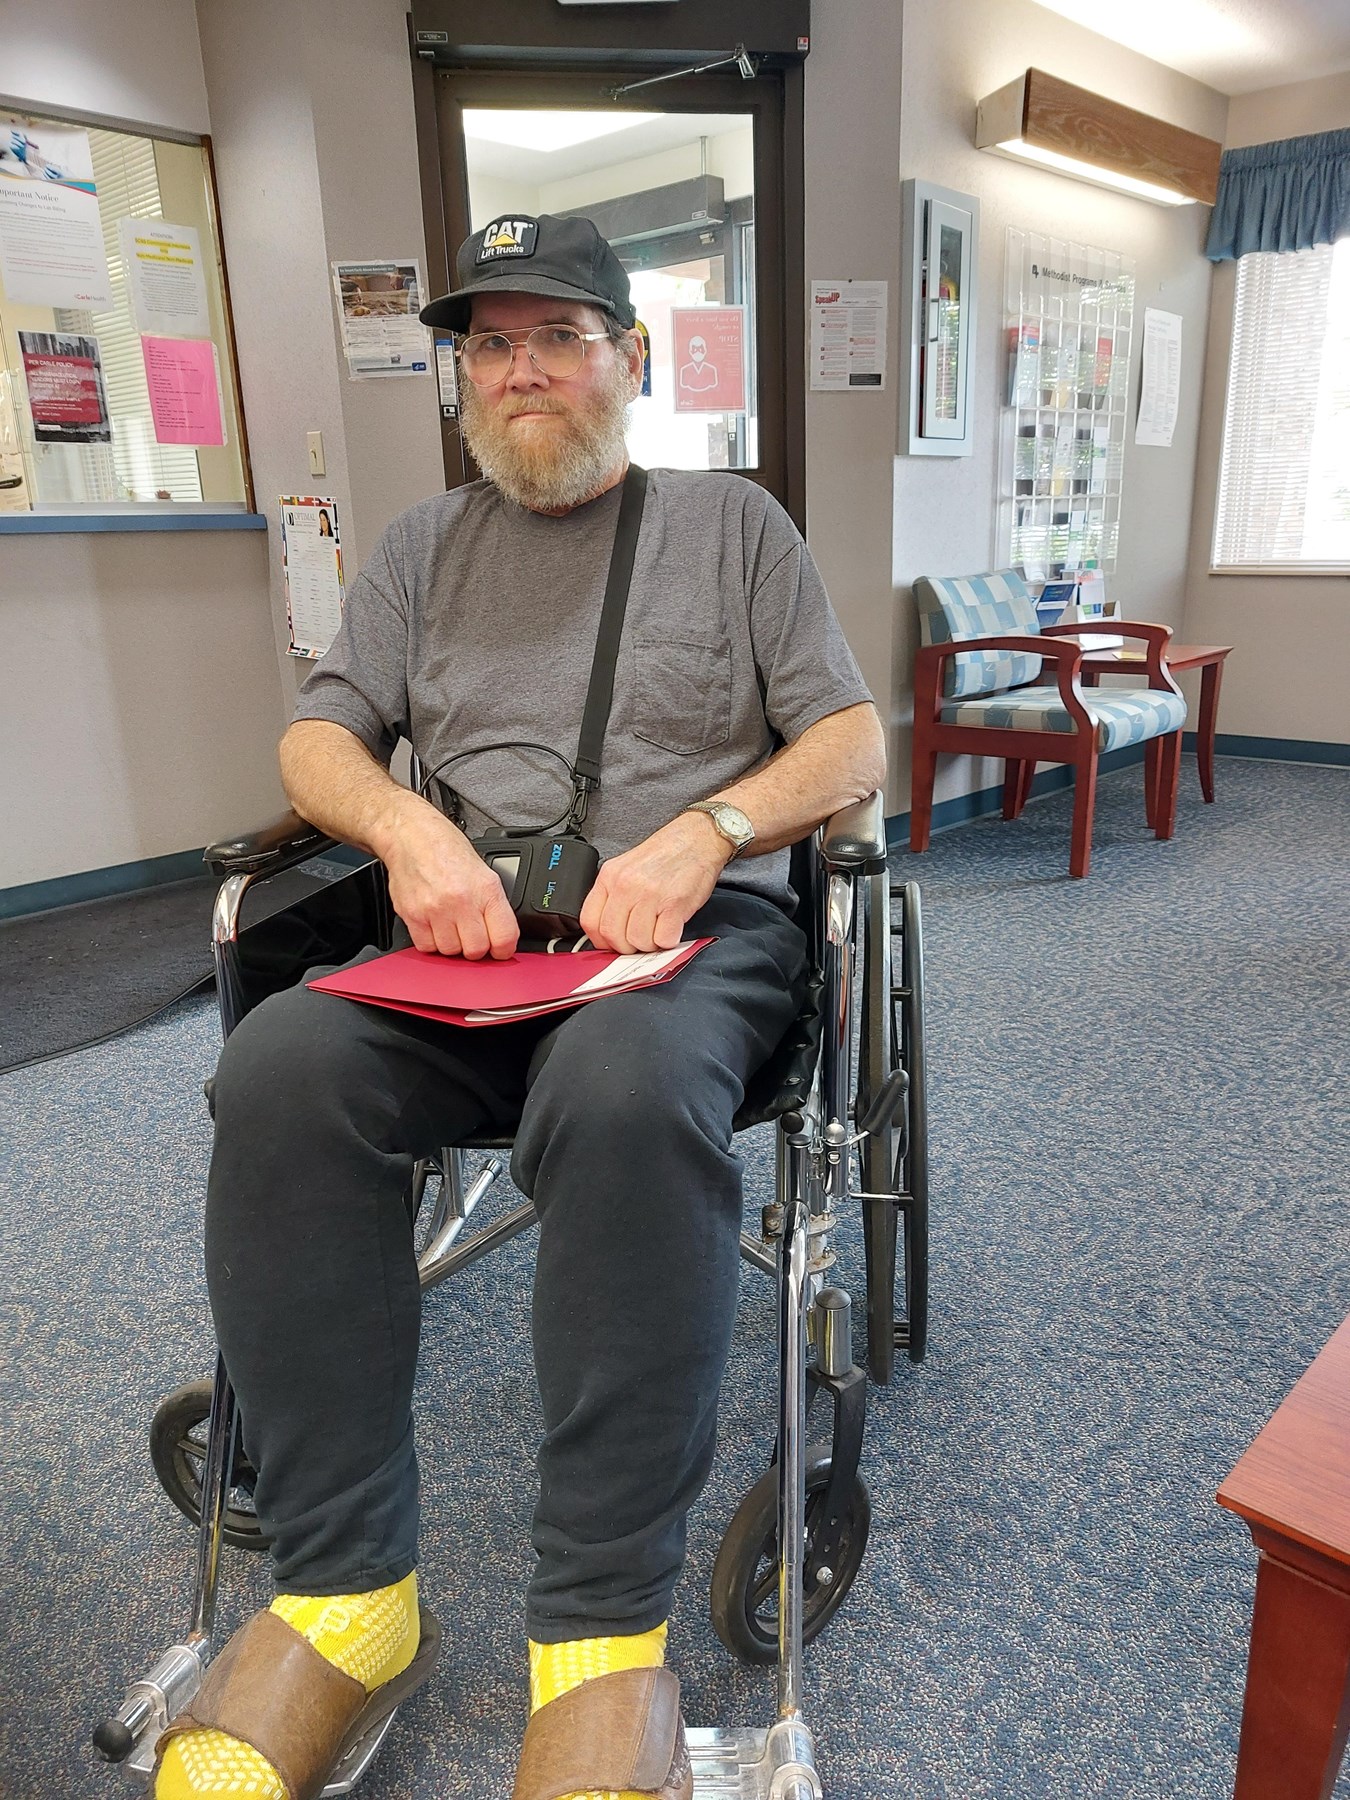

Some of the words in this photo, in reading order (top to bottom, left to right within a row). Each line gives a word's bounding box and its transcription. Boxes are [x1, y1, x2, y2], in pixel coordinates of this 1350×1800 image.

[0, 188, 33, 199] mportant
[35, 191, 59, 202] Notice
[483, 221, 529, 248] CAT
[481, 248, 495, 259] Lift
[496, 245, 524, 255] Trucks
[1042, 267, 1071, 282] Methodist
[1072, 273, 1097, 288] Programs
[549, 844, 563, 870] ZOLL
